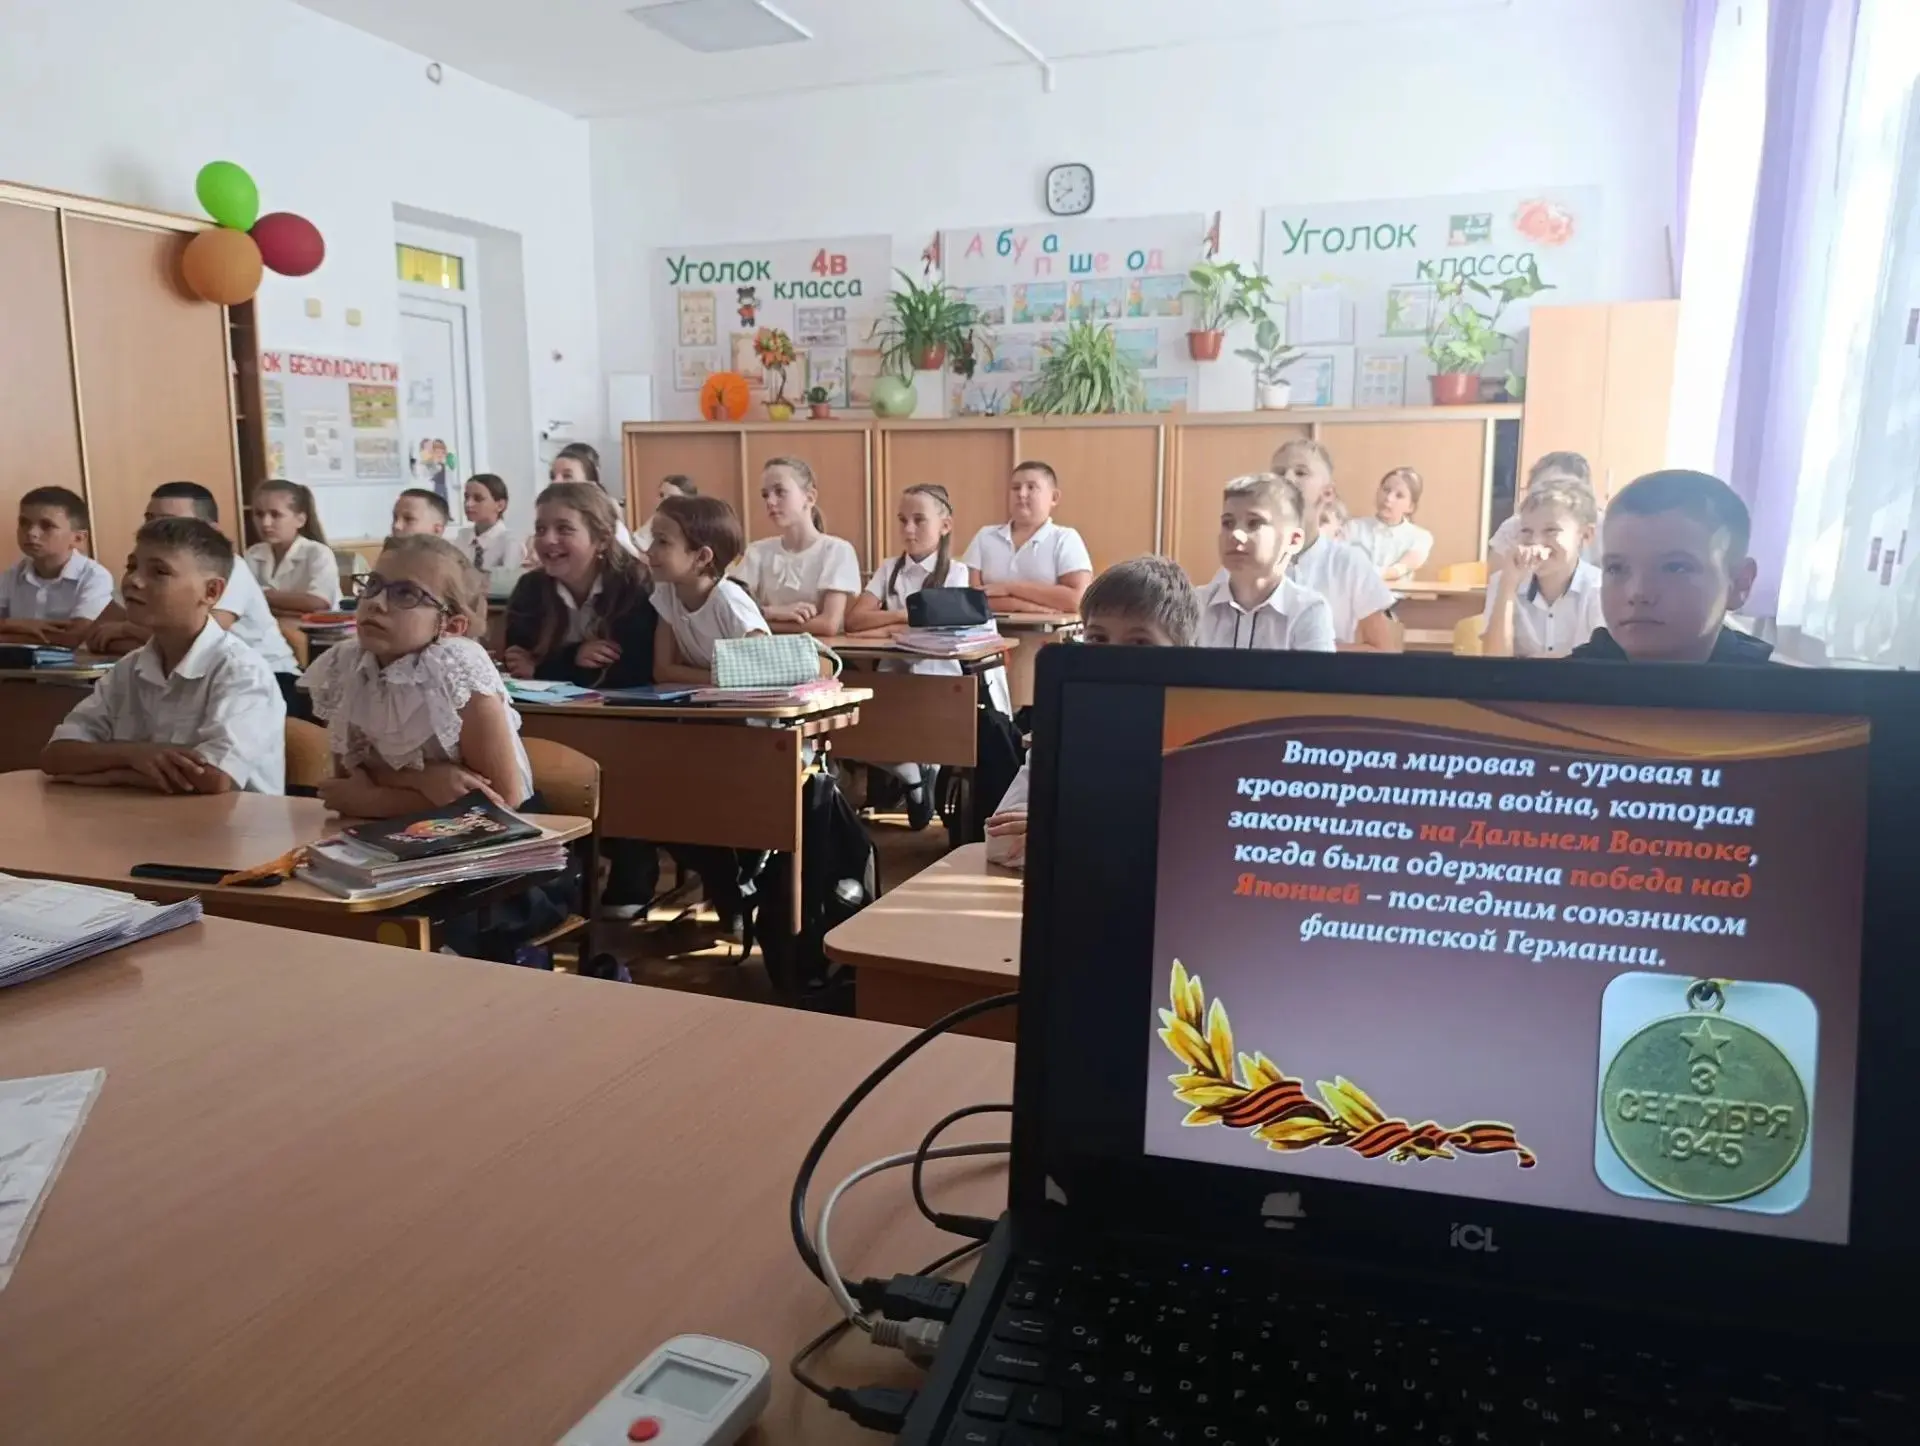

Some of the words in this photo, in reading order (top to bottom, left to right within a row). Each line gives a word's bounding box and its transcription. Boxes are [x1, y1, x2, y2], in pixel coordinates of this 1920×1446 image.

[1282, 218, 1418, 255] Уголок
[666, 254, 772, 286] Уголок
[773, 278, 863, 300] класса
[1416, 252, 1536, 281] класса
[1282, 740, 1397, 773] Вторая
[1403, 753, 1535, 779] мировая
[1567, 760, 1692, 788] суровая
[1701, 768, 1721, 788] и
[1237, 777, 1493, 811] кровопролитная
[1499, 791, 1600, 820] война,
[1609, 799, 1755, 830] которая
[1228, 811, 1414, 840] закончилась
[1419, 823, 1455, 844] на
[1460, 820, 1600, 851] Дальнем
[1607, 830, 1758, 867] Востоке,
[1234, 841, 1316, 867] когда
[1323, 845, 1400, 873] была
[1406, 852, 1563, 886] одержана
[1570, 866, 1683, 895] победа
[1691, 873, 1752, 899] над
[1234, 873, 1361, 906] Японией
[1388, 890, 1556, 922] последним
[1563, 906, 1748, 936] союзником
[1300, 913, 1498, 952] фашистской
[1504, 930, 1667, 967] Германии.
[1690, 1061, 1718, 1096] 3
[1615, 1088, 1796, 1140] СЕНТЯБРЯ
[1658, 1124, 1745, 1169] 1945
[1124, 1332, 1143, 1344] W
[1178, 1342, 1190, 1353] E
[1232, 1350, 1245, 1361] R
[1347, 1368, 1360, 1380] Y
[1402, 1378, 1416, 1391] U
[1122, 1370, 1136, 1382] S
[1179, 1379, 1193, 1391] D
[1233, 1389, 1246, 1400] F
[1087, 1404, 1101, 1416] Z
